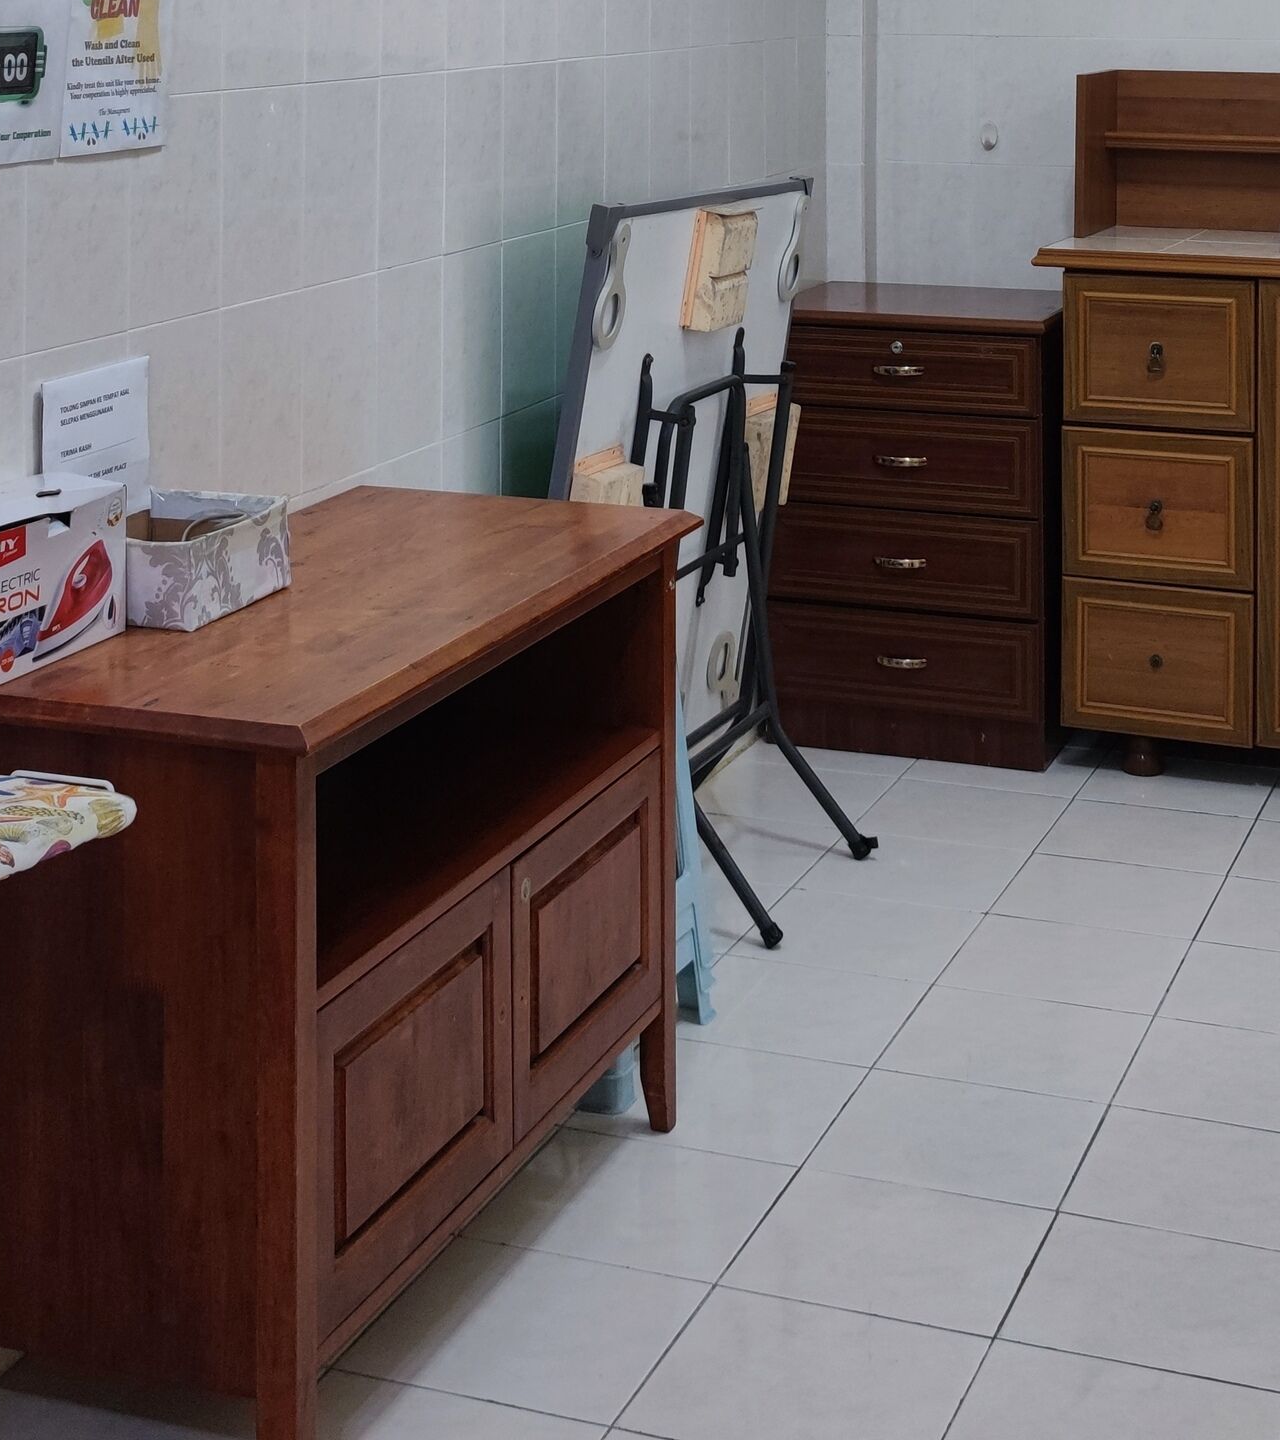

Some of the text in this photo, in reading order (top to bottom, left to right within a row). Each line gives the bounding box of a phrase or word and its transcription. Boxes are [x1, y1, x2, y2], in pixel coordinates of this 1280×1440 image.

[84, 39, 141, 51] Wash and Clean
[72, 53, 155, 67] the Utensils After Used
[3, 52, 29, 82] 00
[67, 81, 83, 92] Kindly
[12, 129, 52, 141] Cooperation
